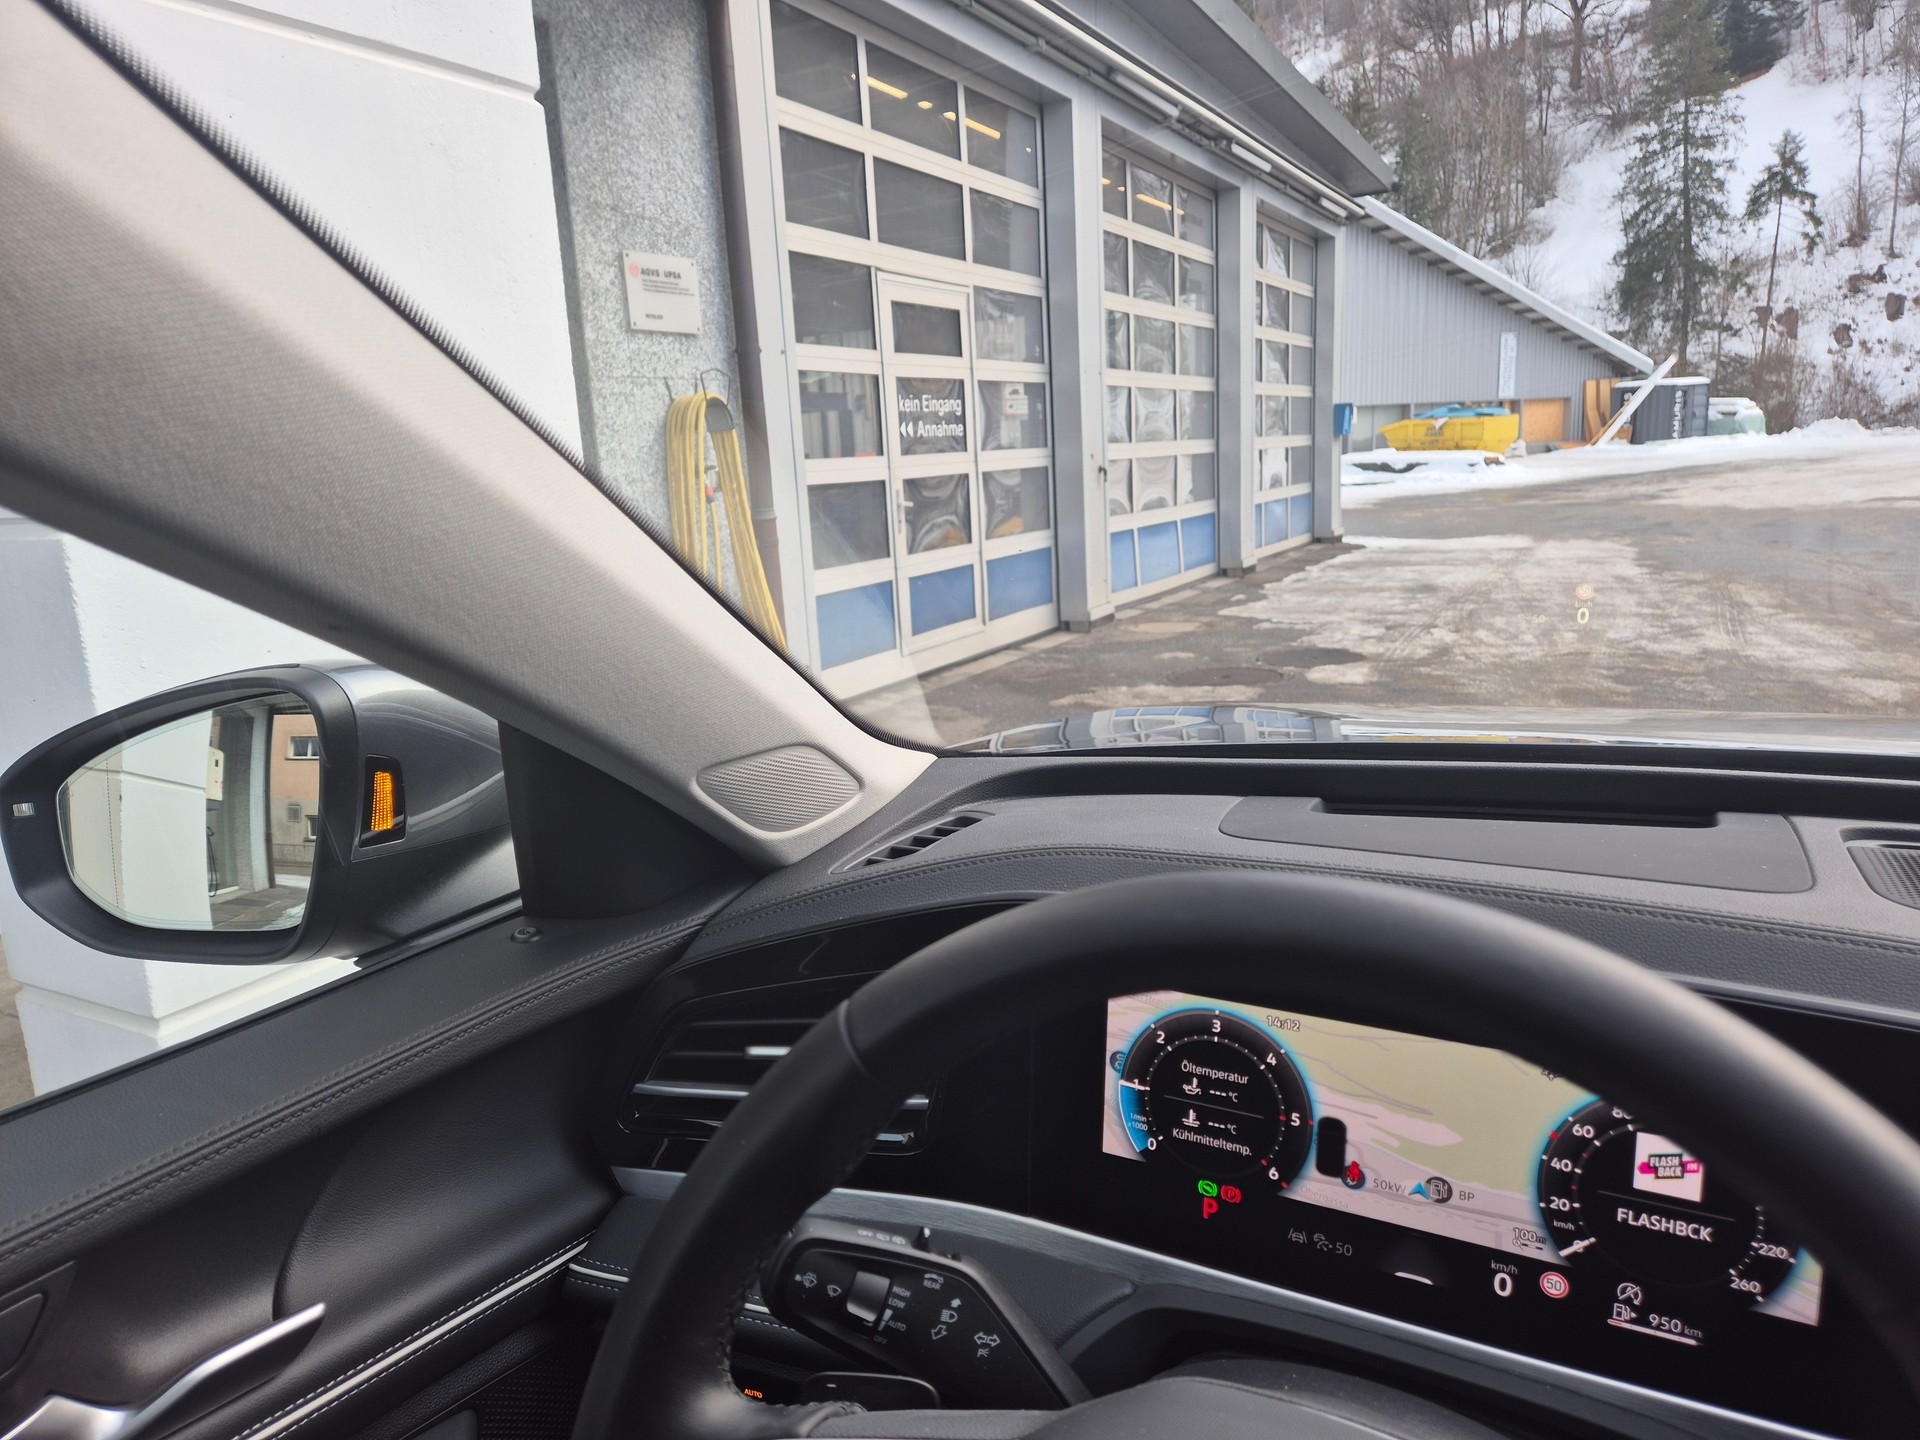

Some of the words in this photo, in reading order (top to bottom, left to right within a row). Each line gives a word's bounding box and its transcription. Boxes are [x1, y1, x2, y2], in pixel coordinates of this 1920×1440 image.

[663, 270, 682, 280] UPSA
[898, 394, 920, 412] kein
[921, 394, 962, 416] Eingang
[917, 420, 964, 438] Annahme
[1577, 607, 1590, 625] 0
[1212, 1019, 1221, 1033] 3
[1267, 1015, 1301, 1032] 14:12
[1156, 1031, 1166, 1044] 2
[1266, 1053, 1277, 1067] 4
[1181, 1059, 1249, 1085] Öltemperatur
[1129, 1112, 1148, 1123] 1/min
[1291, 1113, 1301, 1127] 5
[1572, 1123, 1595, 1139] 60
[1147, 1137, 1157, 1151] 0
[1172, 1128, 1253, 1157] Kühlmitteltemp.
[1550, 1157, 1573, 1173] 40
[1650, 1156, 1680, 1167] FLASH
[1686, 1162, 1698, 1172] FM
[1268, 1166, 1280, 1181] 6
[1658, 1166, 1683, 1177] BACK
[1459, 1190, 1475, 1202] BP
[1203, 1197, 1218, 1219] P
[1549, 1196, 1570, 1211] 20
[1553, 1218, 1575, 1231] km/h
[1616, 1207, 1714, 1243] FLASHBCK
[1336, 1243, 1353, 1257] 50
[1757, 1242, 1788, 1260] 220
[1490, 1259, 1518, 1276] km/h
[892, 1285, 911, 1298] HIGH
[923, 1279, 941, 1291] REAR
[1493, 1272, 1513, 1298] 0
[1545, 1277, 1562, 1293] 50
[1729, 1276, 1762, 1294] 260
[888, 1297, 906, 1309] LOW
[887, 1319, 907, 1332] AUTO
[1649, 1313, 1683, 1334] 950
[1684, 1325, 1703, 1339] km
[873, 1334, 888, 1345] OFF
[744, 1388, 763, 1399] AUTO
